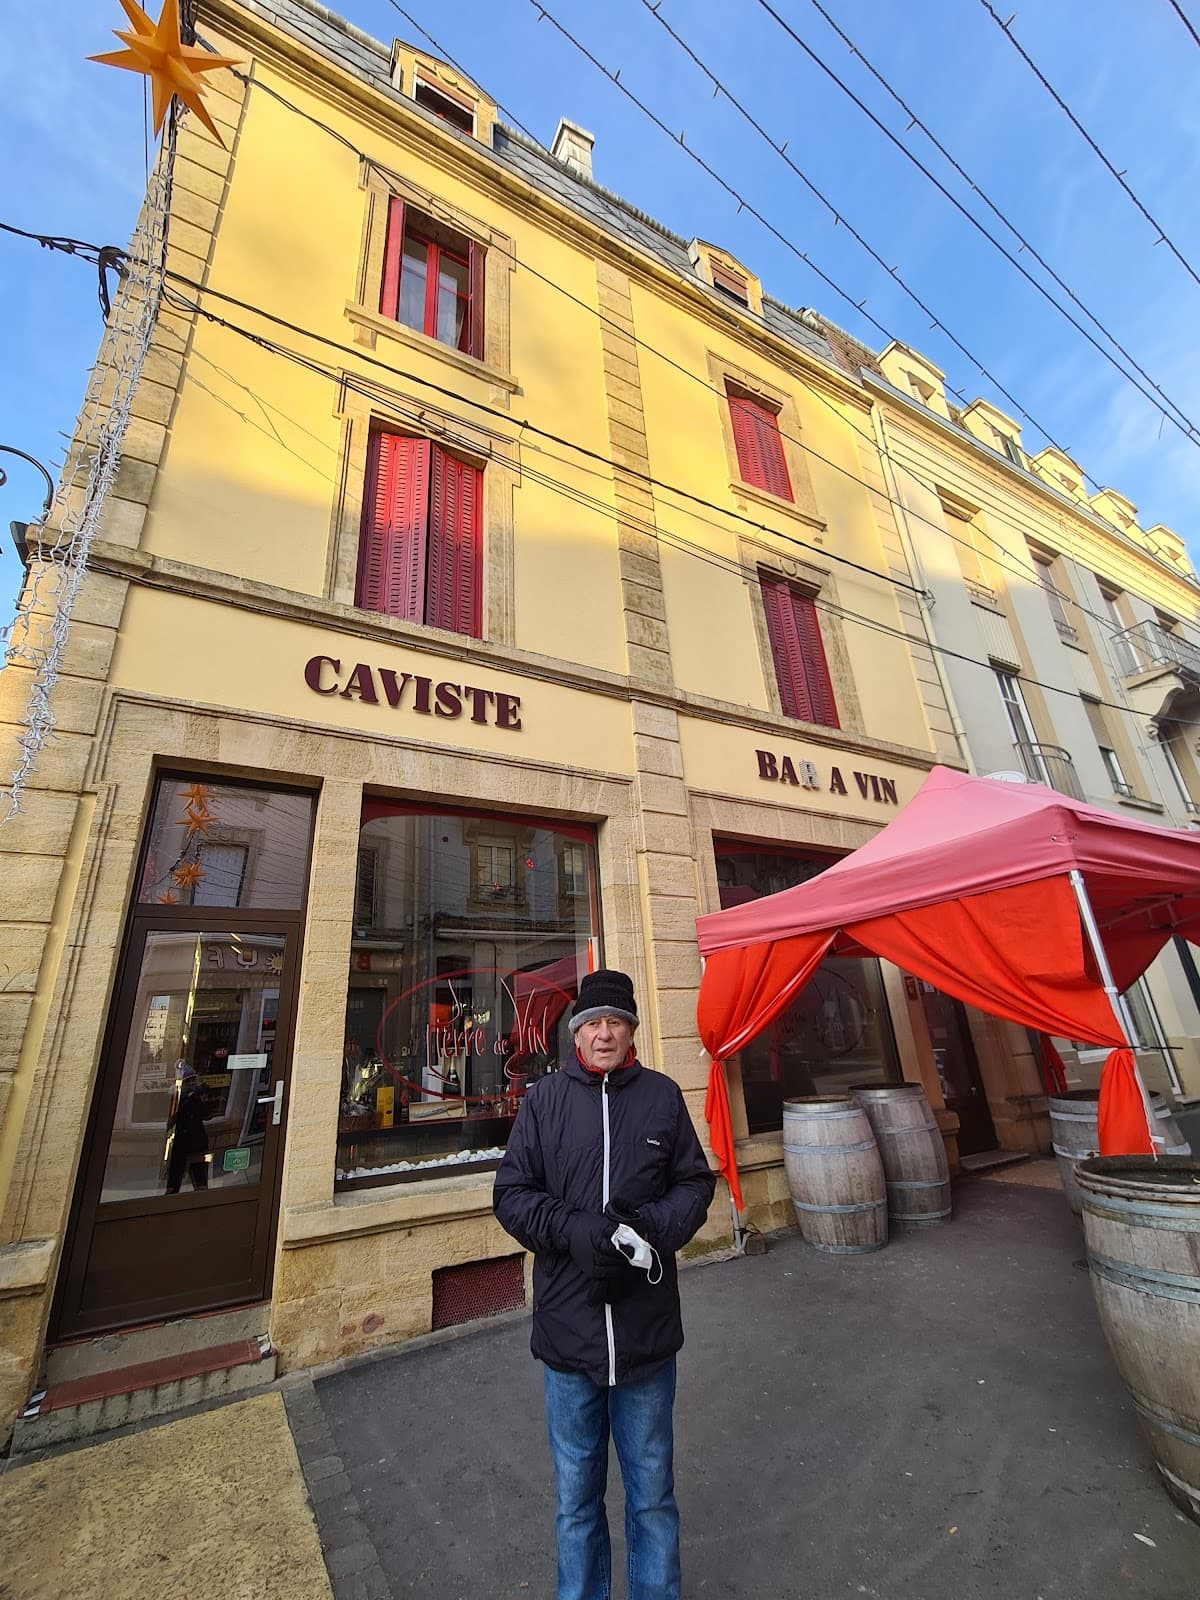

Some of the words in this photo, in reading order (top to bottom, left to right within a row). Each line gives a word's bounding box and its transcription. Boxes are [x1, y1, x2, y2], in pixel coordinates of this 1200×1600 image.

[304, 656, 522, 730] CAVISTE
[755, 750, 819, 790] BAR
[829, 766, 848, 795] A
[853, 771, 898, 806] VIN
[493, 1031, 510, 1055] de
